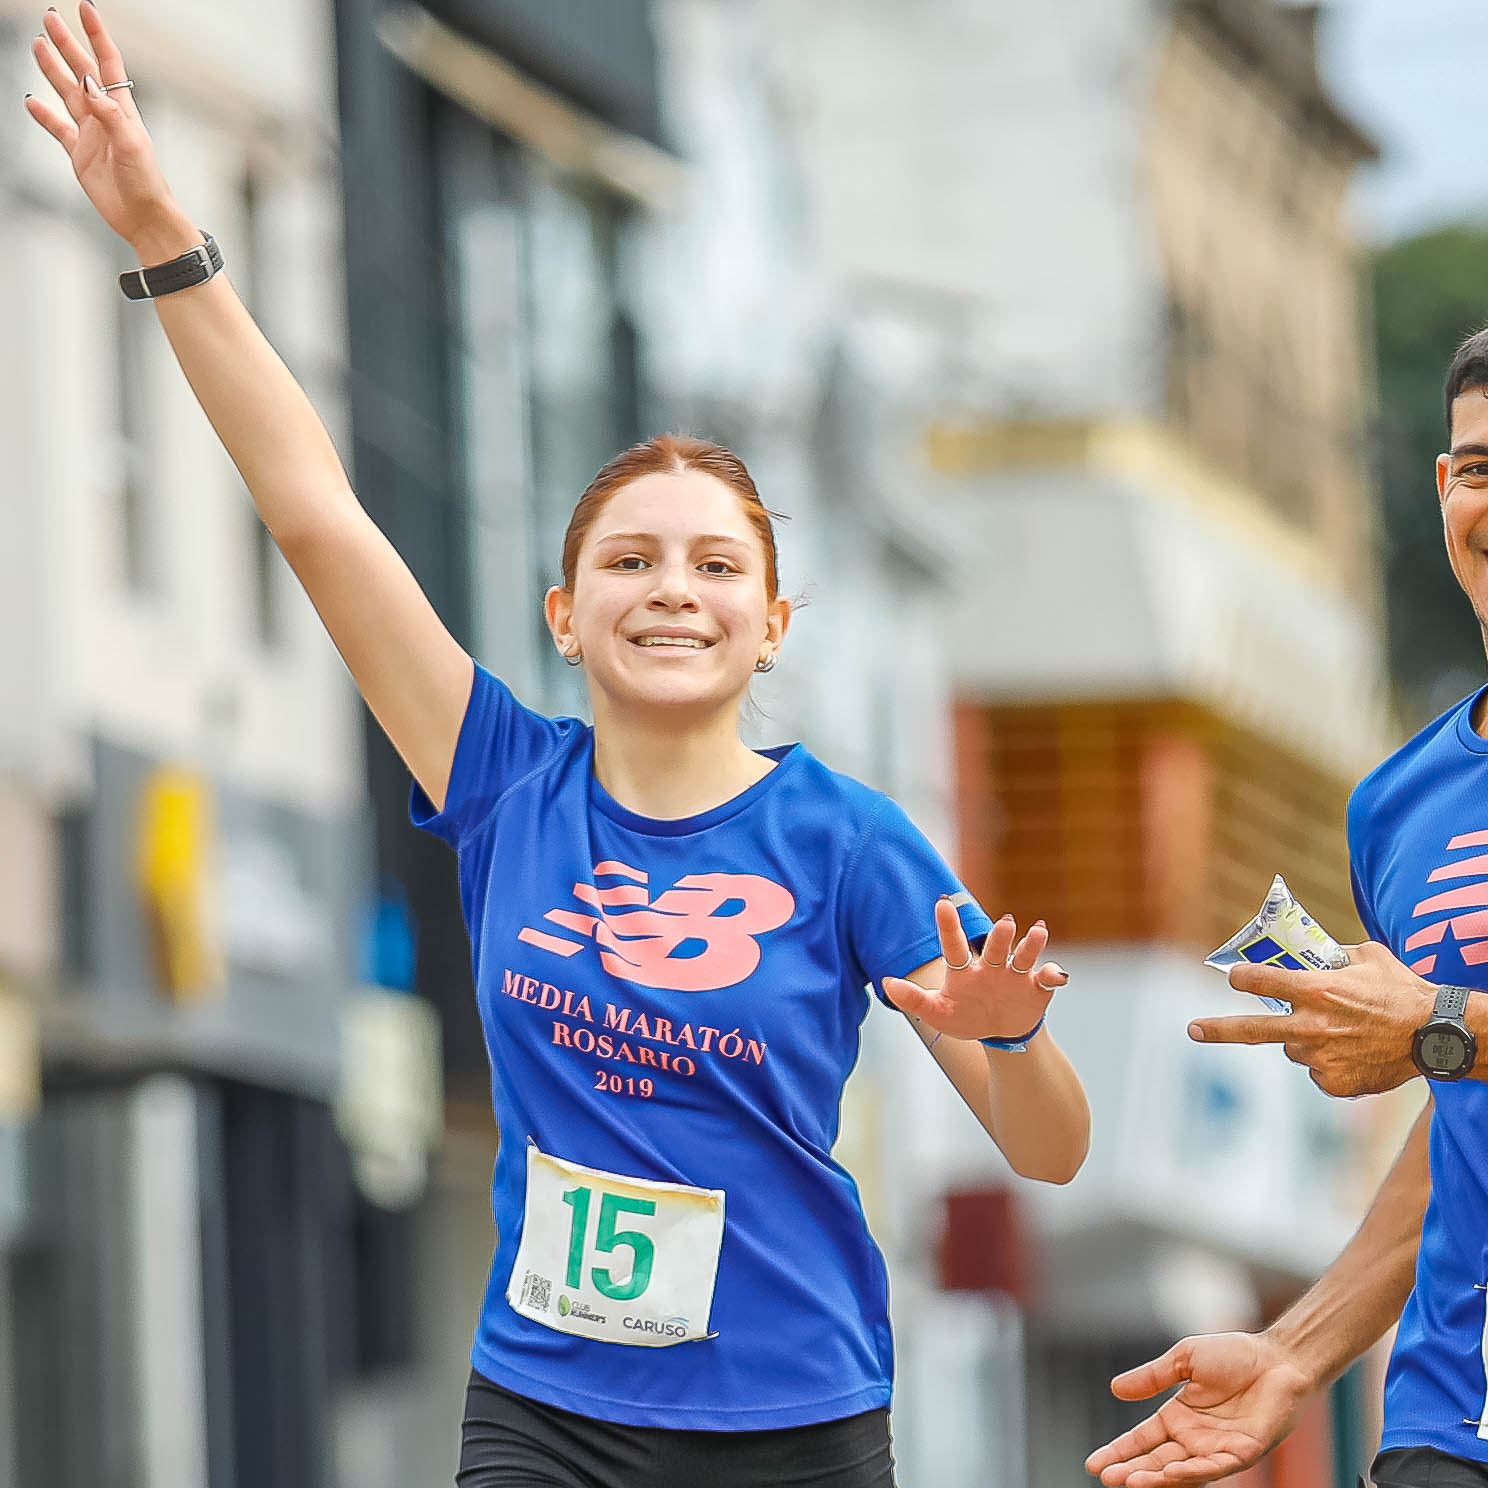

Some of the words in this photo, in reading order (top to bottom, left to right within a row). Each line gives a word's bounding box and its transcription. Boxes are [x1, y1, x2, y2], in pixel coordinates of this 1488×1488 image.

[500, 968, 594, 1022] MEDIA
[604, 1003, 768, 1066] MARATÓN
[551, 1021, 696, 1077] ROSARIO
[594, 1071, 654, 1098] 2019
[562, 1186, 657, 1301] 15
[622, 1316, 687, 1338] CARUSO
